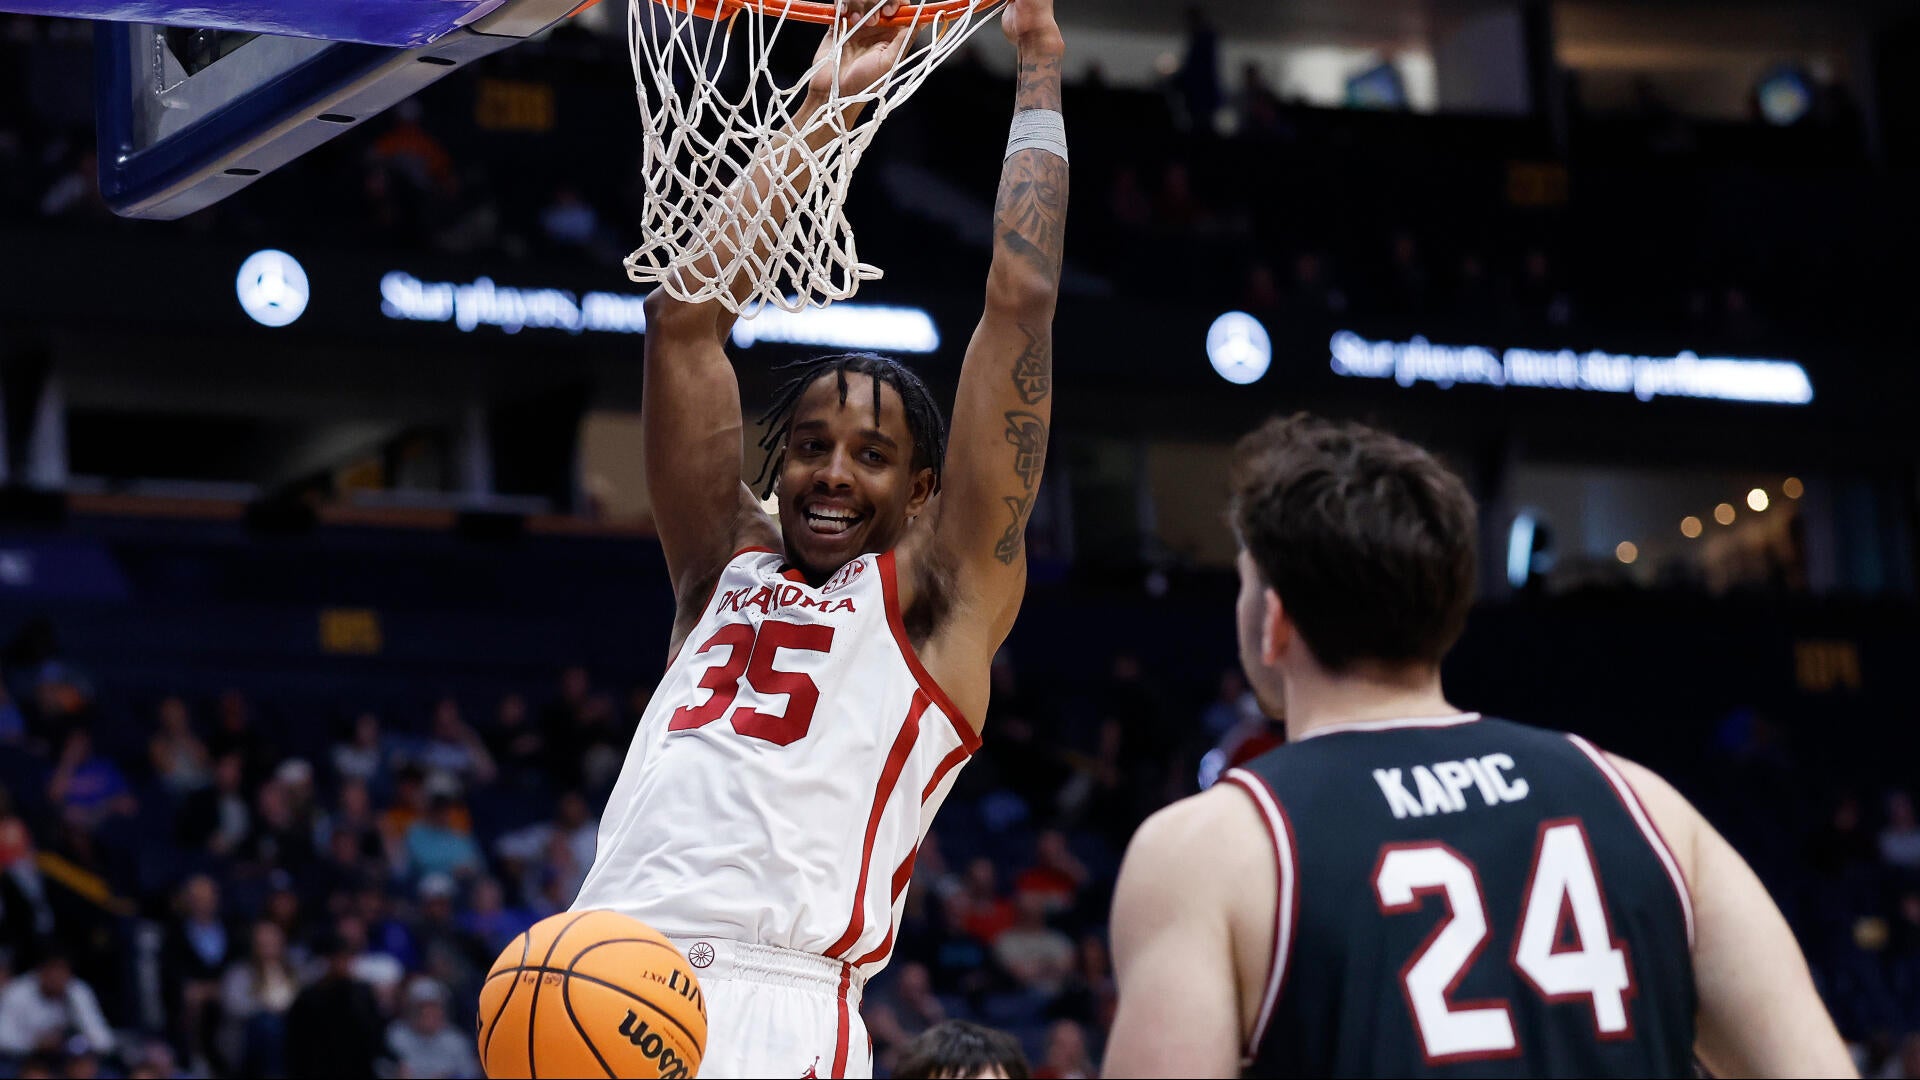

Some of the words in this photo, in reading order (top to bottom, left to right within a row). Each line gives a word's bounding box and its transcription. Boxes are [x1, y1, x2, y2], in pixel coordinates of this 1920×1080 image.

[668, 620, 835, 746] 35
[1373, 753, 1529, 818] KAPIC
[641, 969, 667, 985] NXT
[1370, 816, 1638, 1068] 24
